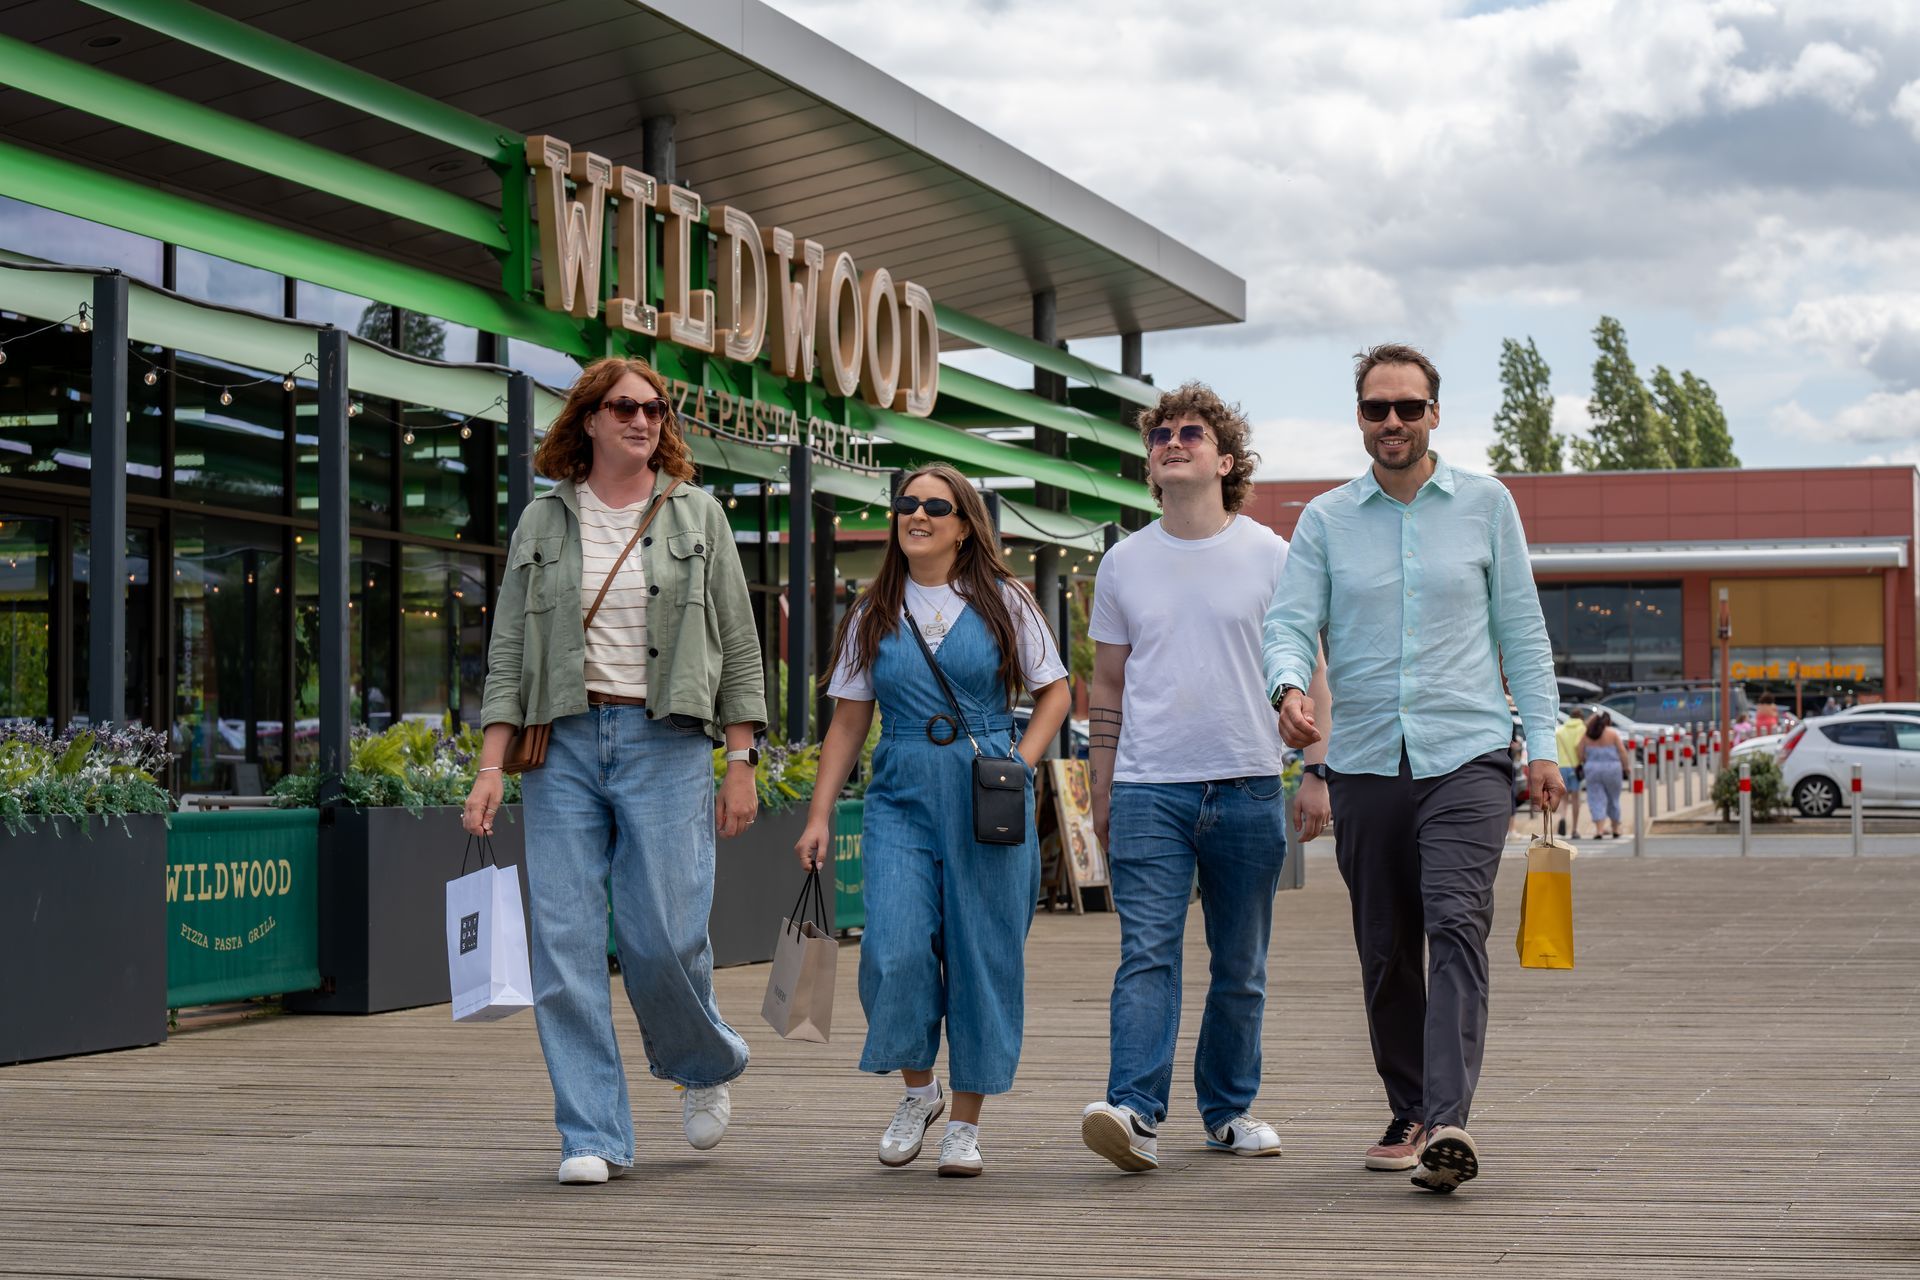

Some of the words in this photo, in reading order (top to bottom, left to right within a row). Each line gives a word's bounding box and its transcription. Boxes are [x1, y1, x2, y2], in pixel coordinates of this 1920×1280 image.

[526, 134, 939, 417] WILDWOOD
[716, 390, 800, 455] PASTA
[808, 415, 880, 479] GRILL
[1731, 661, 1779, 680] Card
[1787, 660, 1866, 683] Factory
[166, 859, 291, 902] WILDWOOD
[180, 922, 209, 948] PIZZA
[214, 936, 243, 951] PASTA
[248, 916, 276, 944] GRILL
